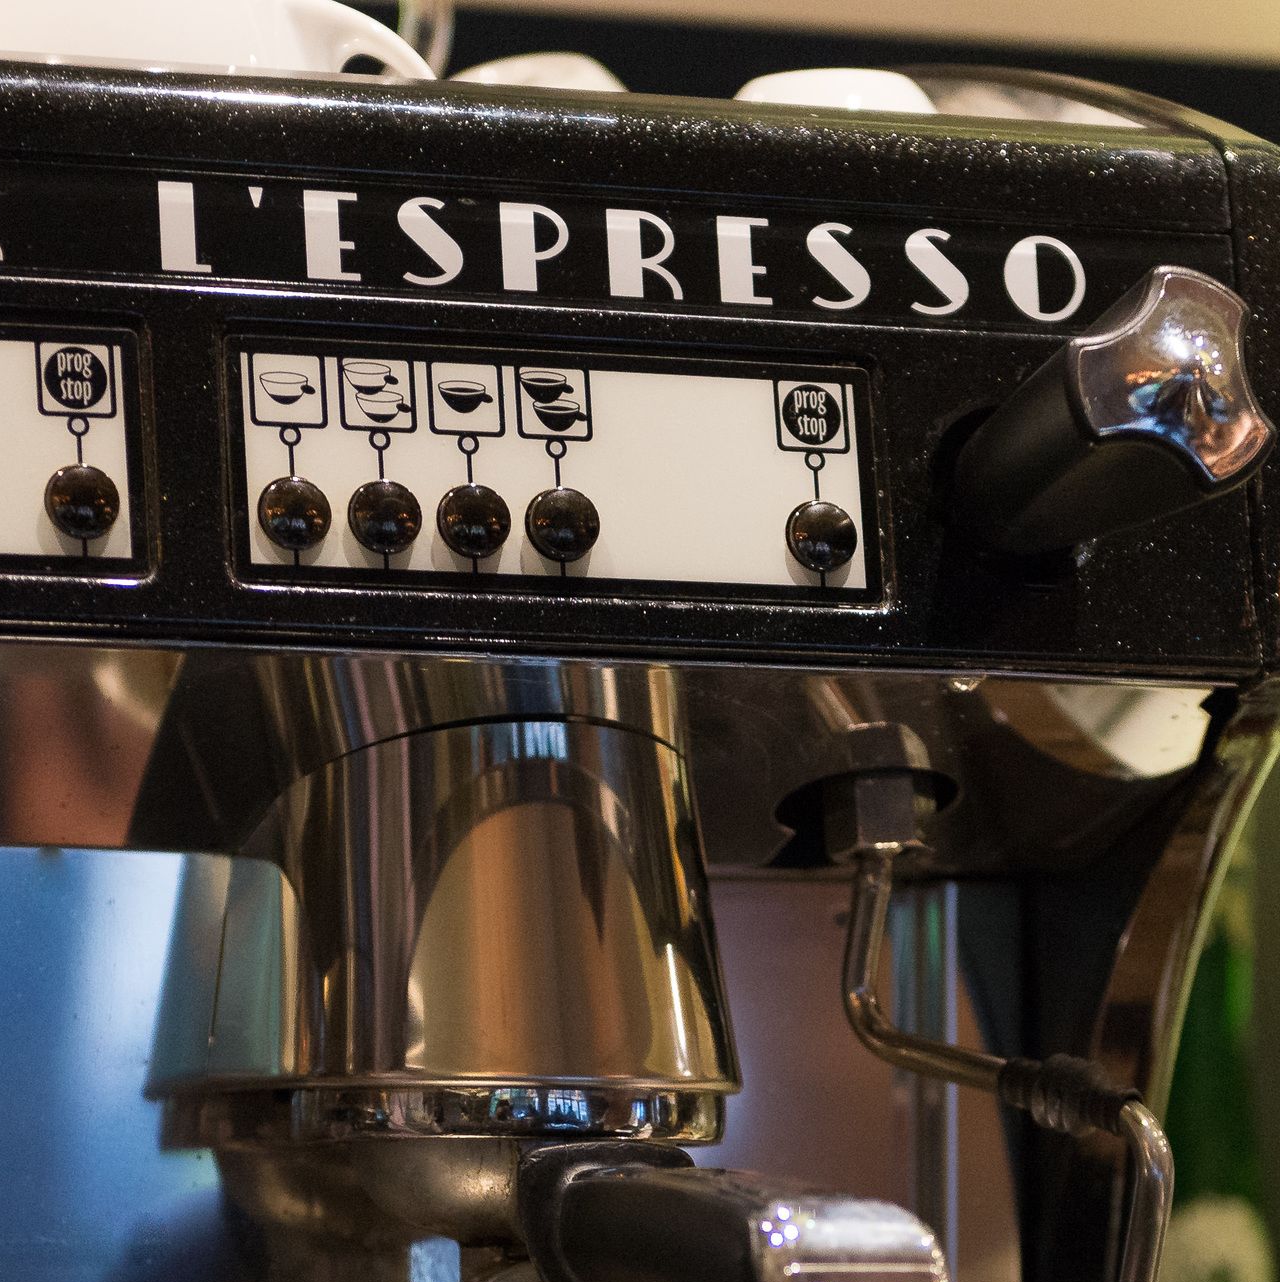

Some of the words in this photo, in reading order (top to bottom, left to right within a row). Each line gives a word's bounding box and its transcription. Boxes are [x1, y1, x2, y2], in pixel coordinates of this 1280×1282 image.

[156, 180, 1086, 323] L'ESPRESSO
[57, 352, 92, 379] prog
[60, 377, 92, 406] stop
[794, 390, 827, 415] prog
[797, 414, 827, 441] stop
